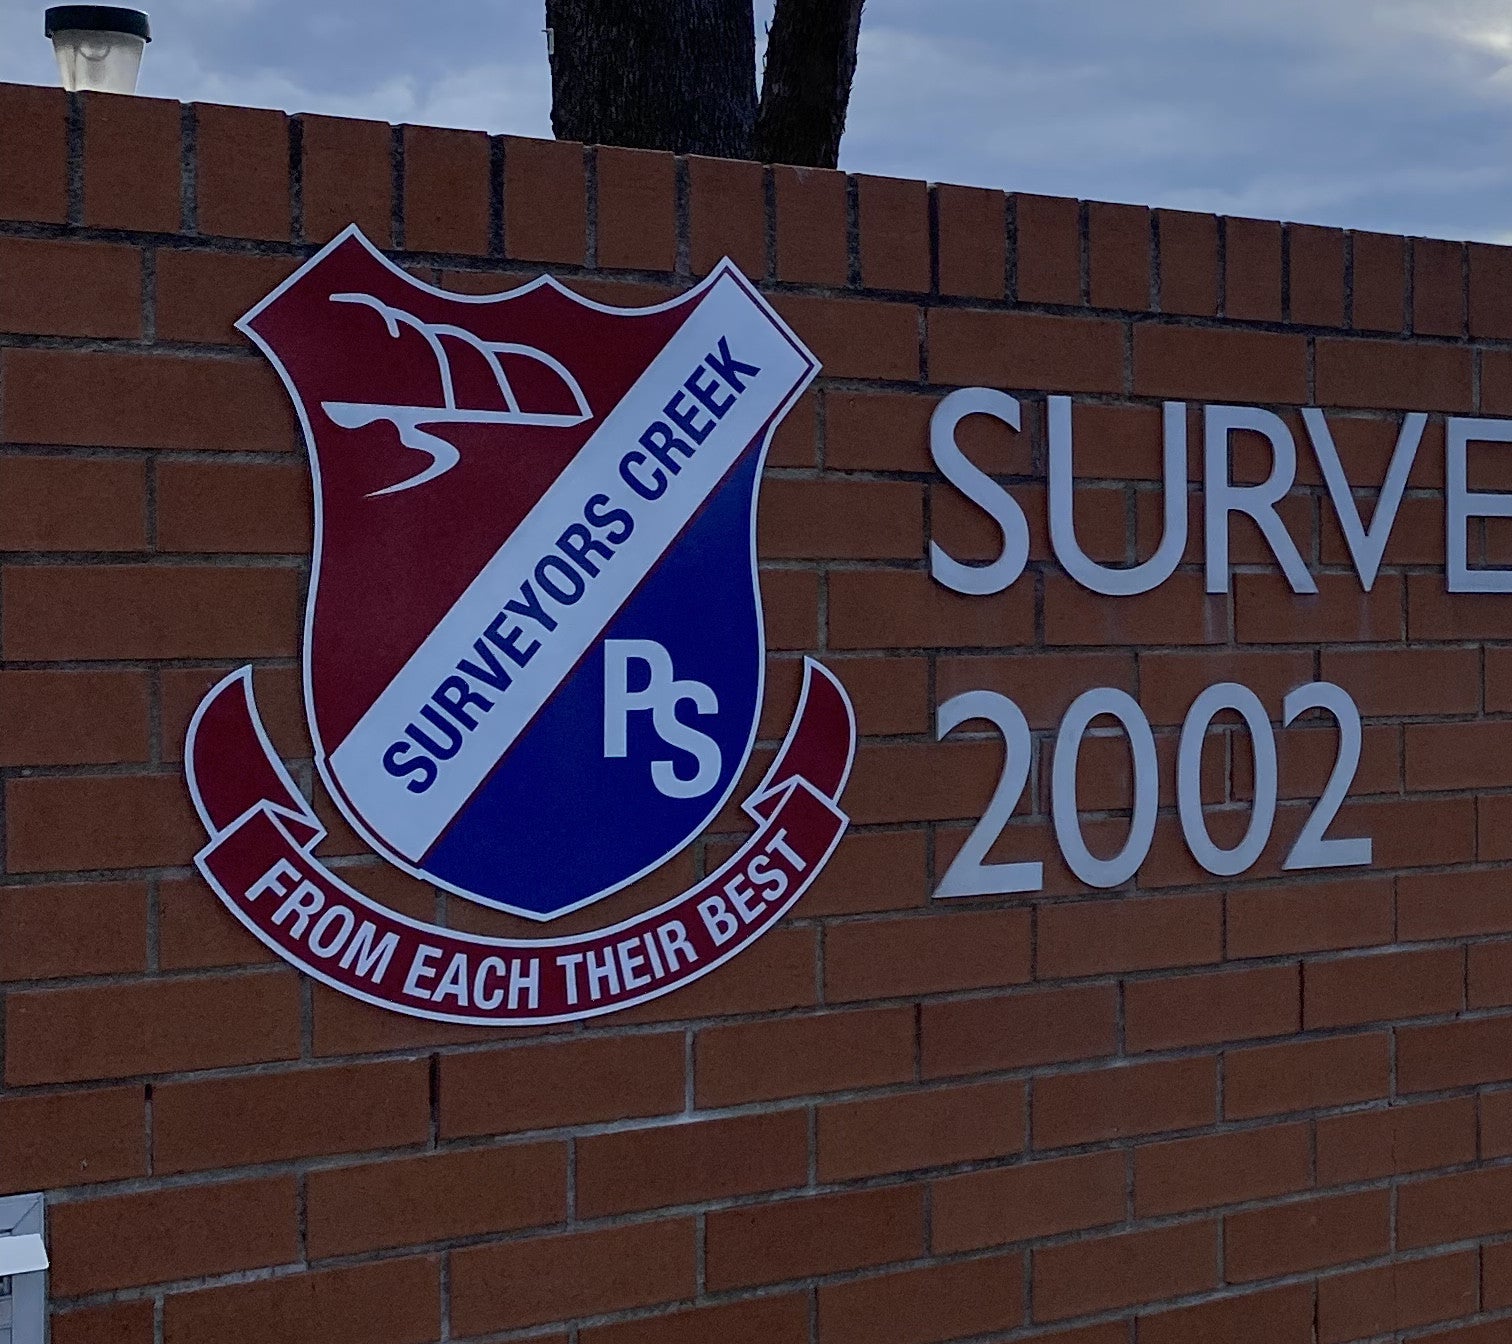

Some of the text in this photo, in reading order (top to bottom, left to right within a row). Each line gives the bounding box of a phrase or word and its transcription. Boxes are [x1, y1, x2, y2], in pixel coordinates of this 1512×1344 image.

[382, 335, 762, 794] SURVEYORS CREEK
[603, 639, 722, 799] PS
[931, 681, 1373, 899] 2002
[245, 829, 809, 1009] FROM EACH THEIR BEST
